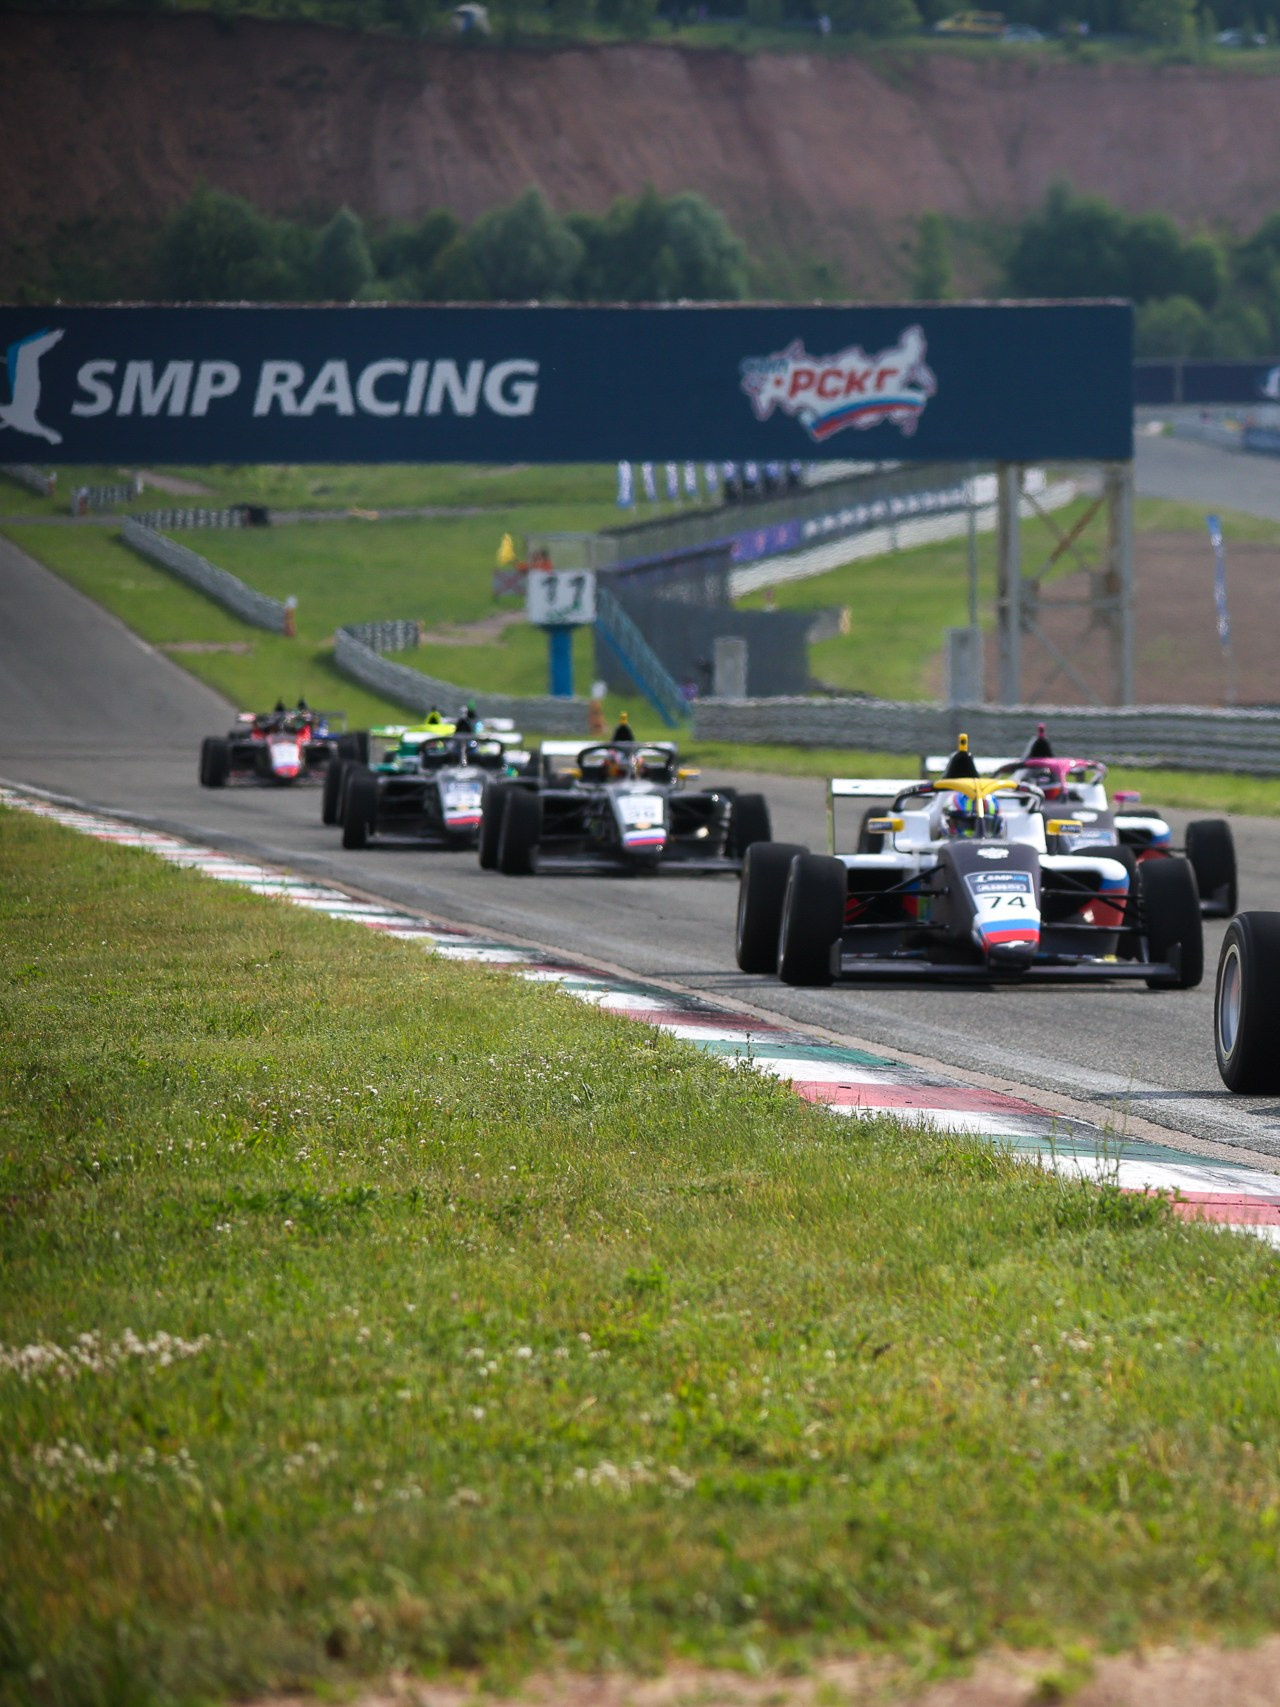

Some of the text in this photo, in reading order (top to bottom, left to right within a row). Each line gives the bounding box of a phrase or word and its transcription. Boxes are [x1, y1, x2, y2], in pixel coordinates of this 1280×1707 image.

[71, 358, 539, 417] SMP RACING
[787, 368, 898, 399] РСКГ
[983, 896, 1027, 909] 74
